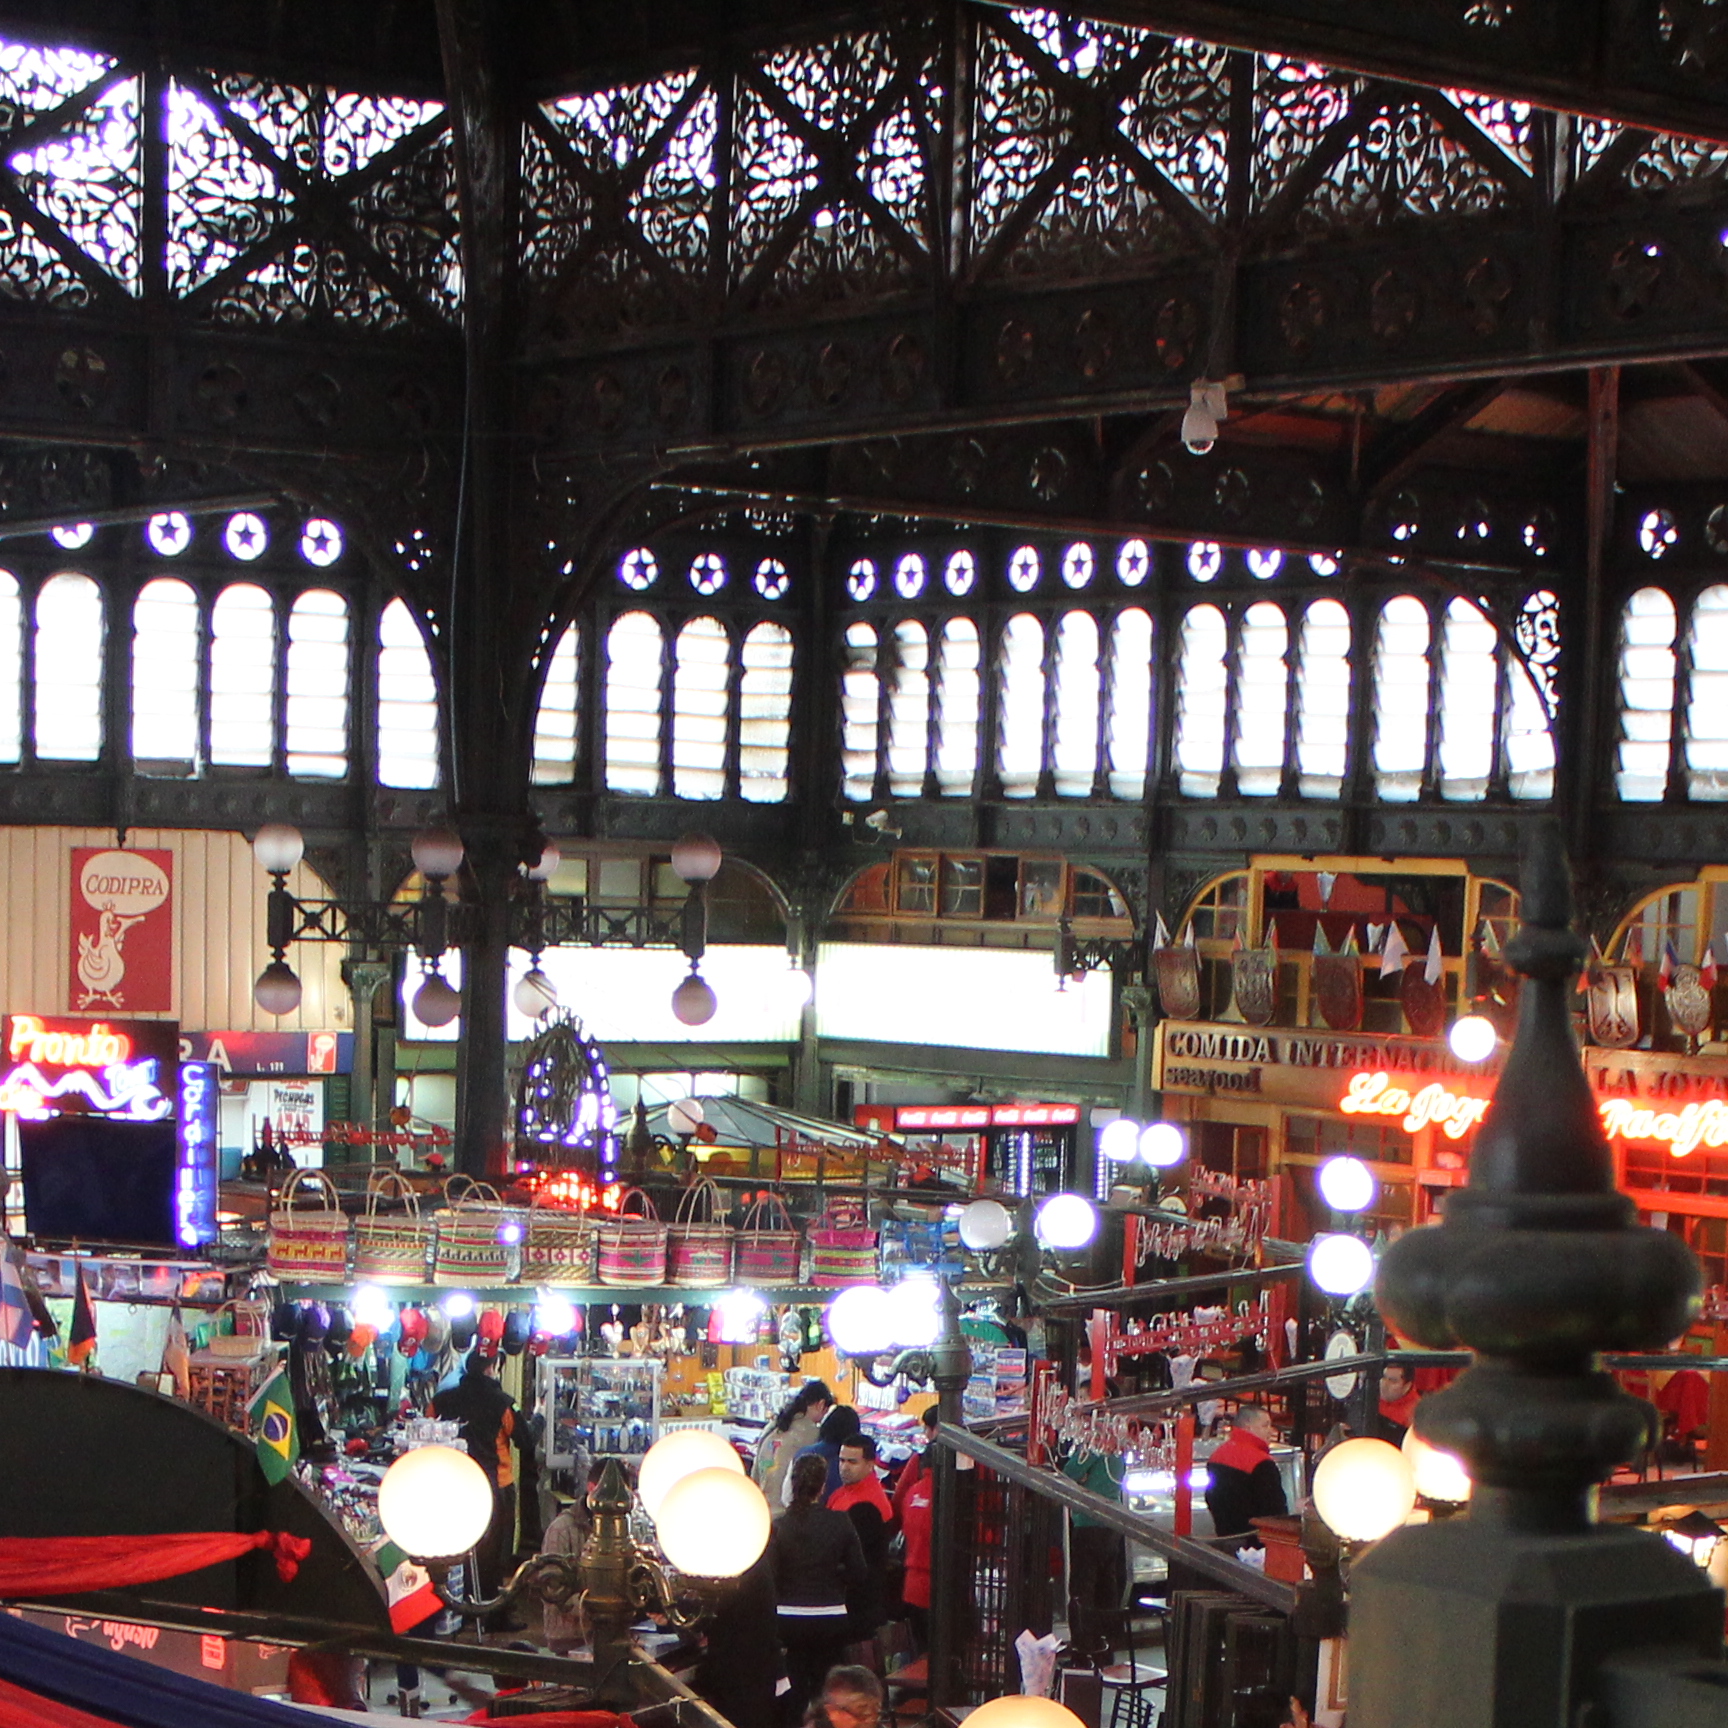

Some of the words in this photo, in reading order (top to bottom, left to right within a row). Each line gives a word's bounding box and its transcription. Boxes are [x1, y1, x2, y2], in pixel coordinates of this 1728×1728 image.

[85, 873, 164, 897] CODIPRA
[9, 1015, 132, 1066] Pronto
[1166, 1031, 1272, 1063] COMIDA
[1340, 1072, 1410, 1117] La
[1596, 1067, 1637, 1098] LA
